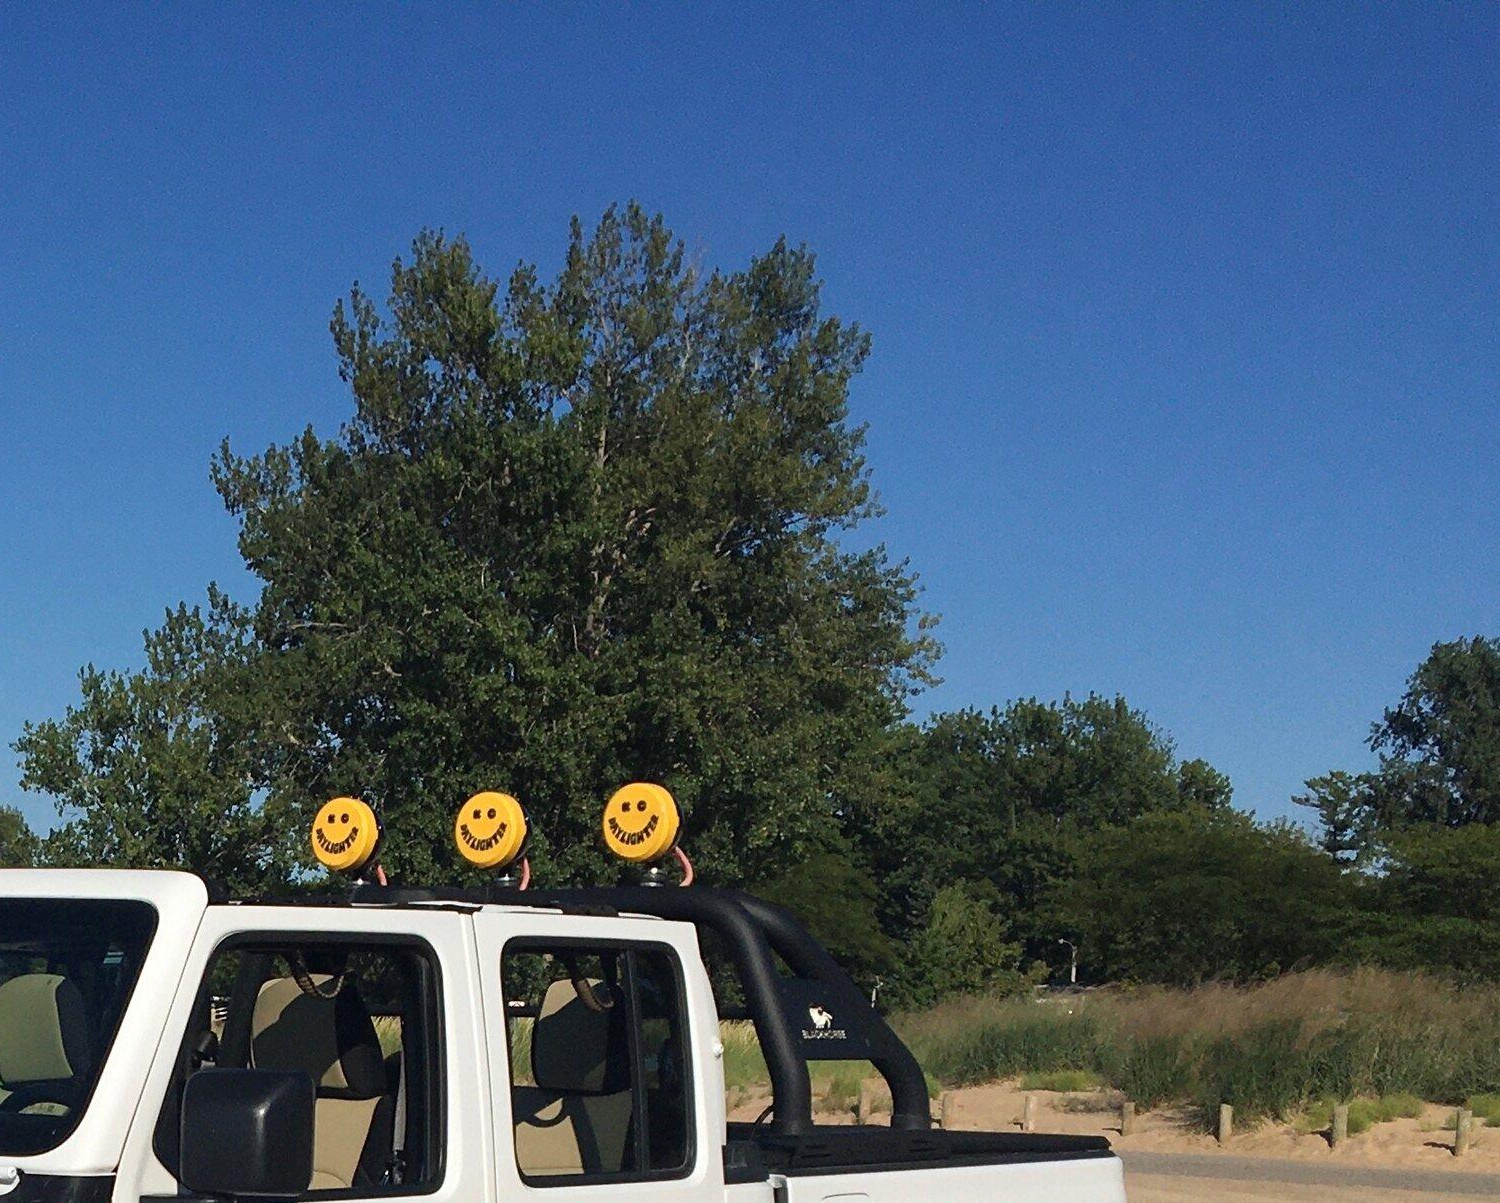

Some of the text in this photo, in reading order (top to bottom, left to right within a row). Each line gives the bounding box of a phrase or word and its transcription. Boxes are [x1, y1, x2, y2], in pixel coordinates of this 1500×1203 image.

[316, 826, 359, 854] DAYLIGHTER
[460, 822, 507, 851] DAYLIGHTER
[608, 814, 659, 846] DAYLIGHTER
